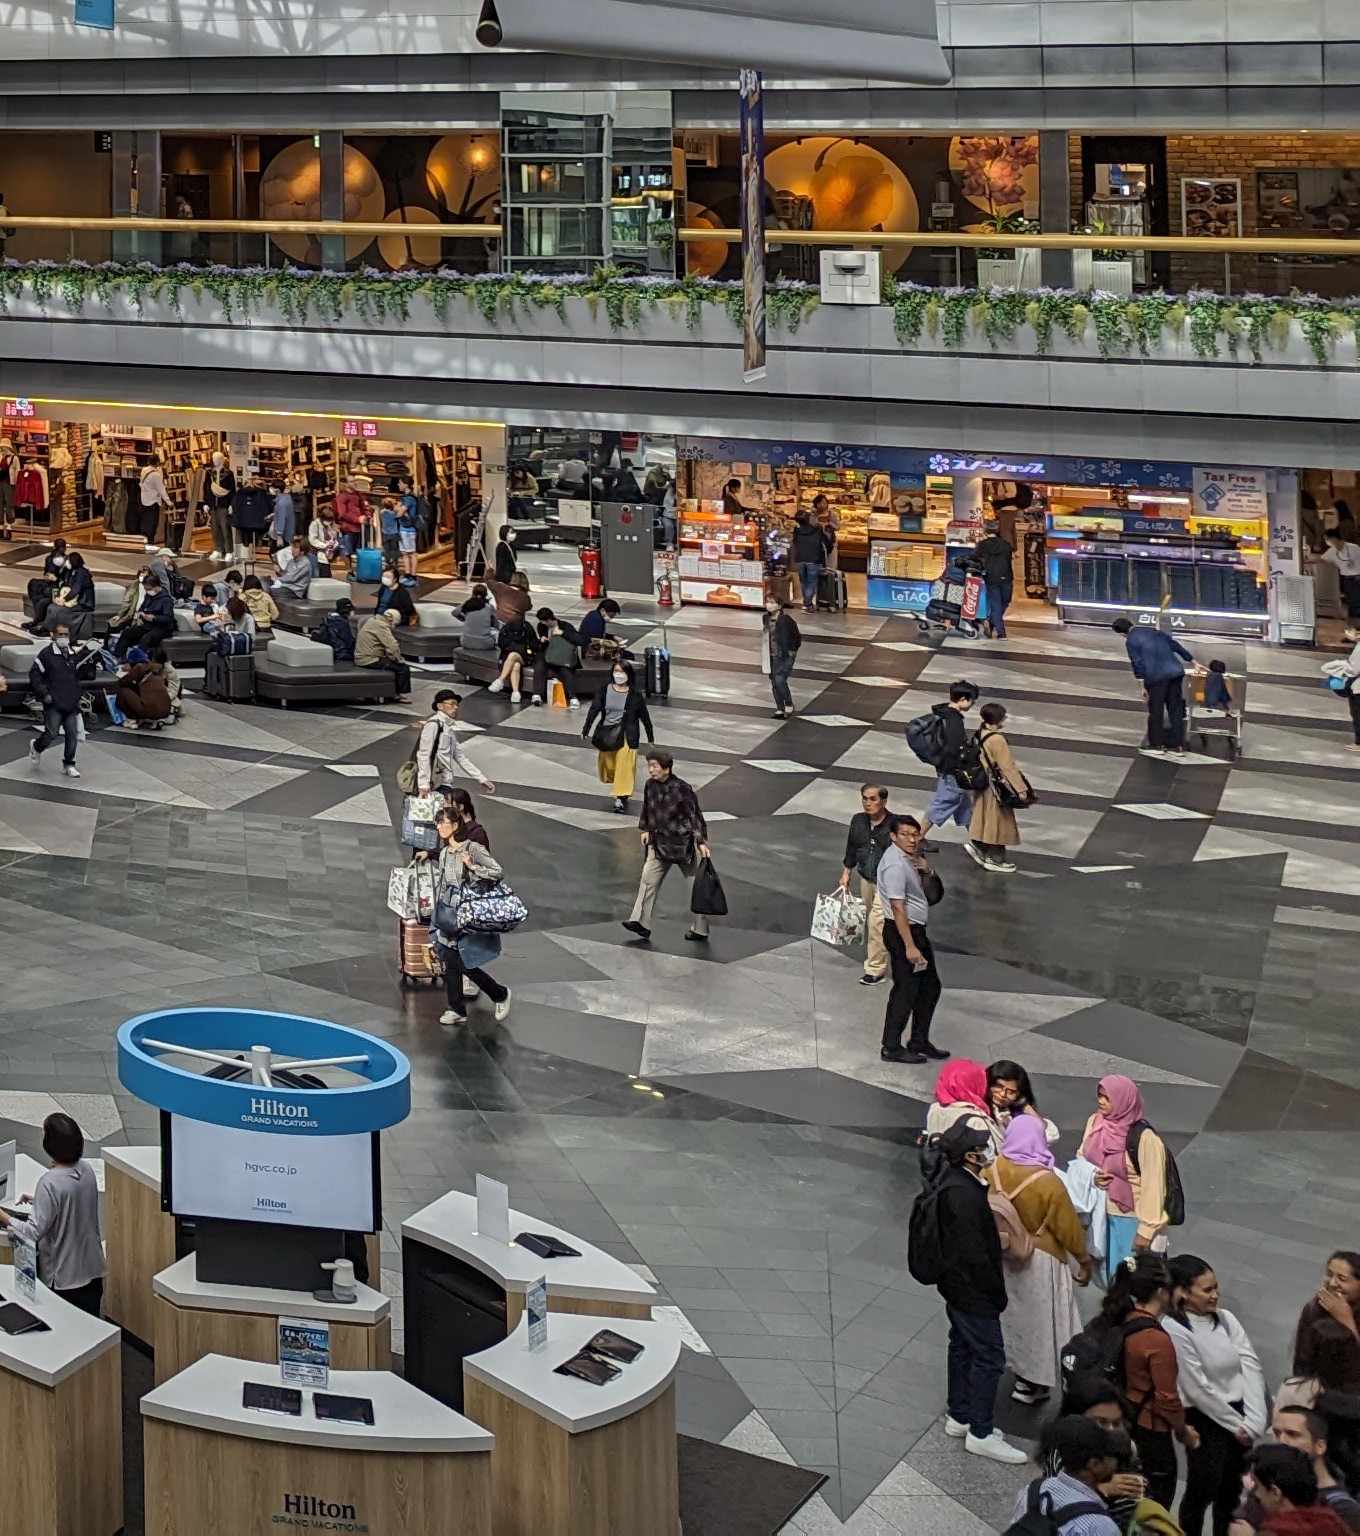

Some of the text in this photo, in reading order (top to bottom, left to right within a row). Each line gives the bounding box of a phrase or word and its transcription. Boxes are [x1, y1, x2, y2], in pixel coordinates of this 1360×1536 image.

[1203, 471, 1256, 484] Tax Free
[1134, 520, 1174, 531] 白い恋人
[250, 1097, 309, 1118] Hilton
[240, 1114, 319, 1128] GRAND VACATIONS
[245, 1161, 297, 1175] hgvc.co.jp
[256, 1197, 287, 1209] Hilton
[284, 1493, 356, 1520] Hilton
[272, 1515, 369, 1533] GRAND VACATIONS
